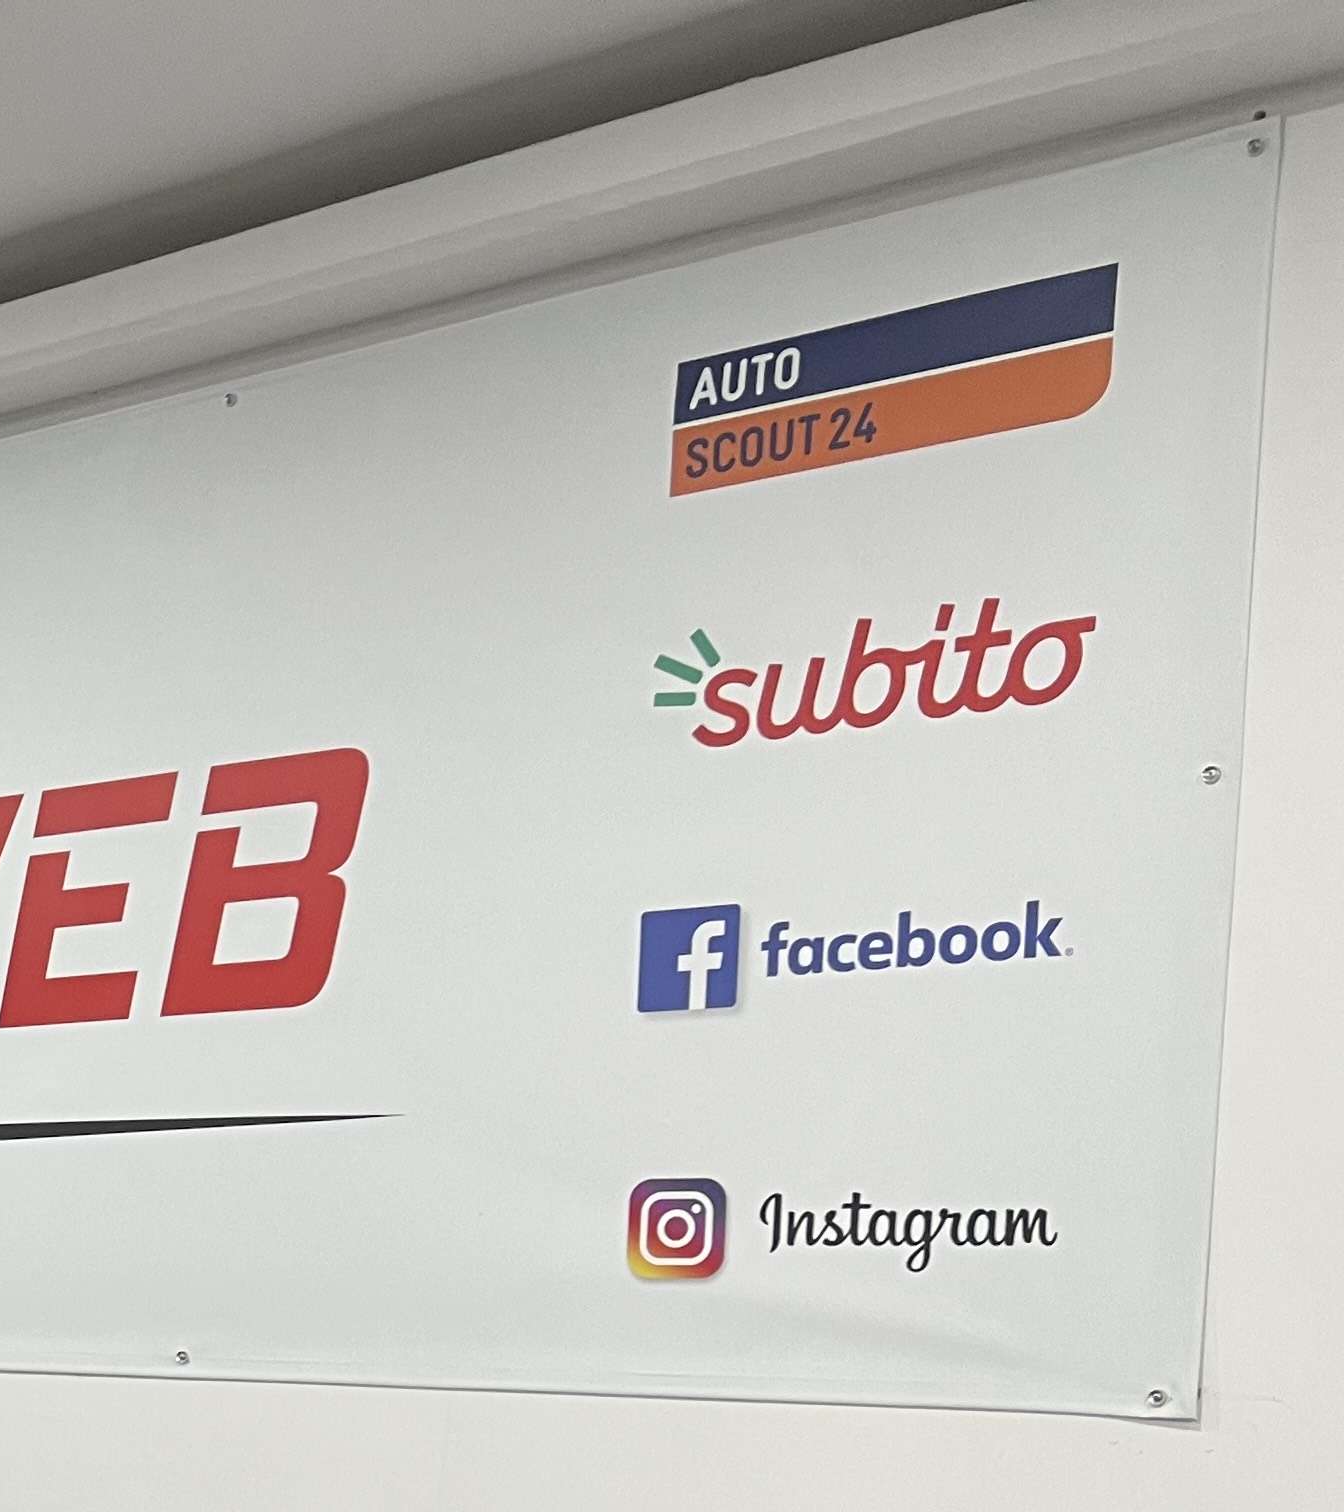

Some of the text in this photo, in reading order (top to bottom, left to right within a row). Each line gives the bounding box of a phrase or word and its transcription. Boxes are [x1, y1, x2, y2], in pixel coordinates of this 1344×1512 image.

[688, 347, 800, 410] AUTO
[685, 402, 877, 479] SCOUT 24
[692, 597, 1097, 748] subito
[677, 900, 1064, 1010] f facebook
[759, 1192, 1058, 1272] Instagram
